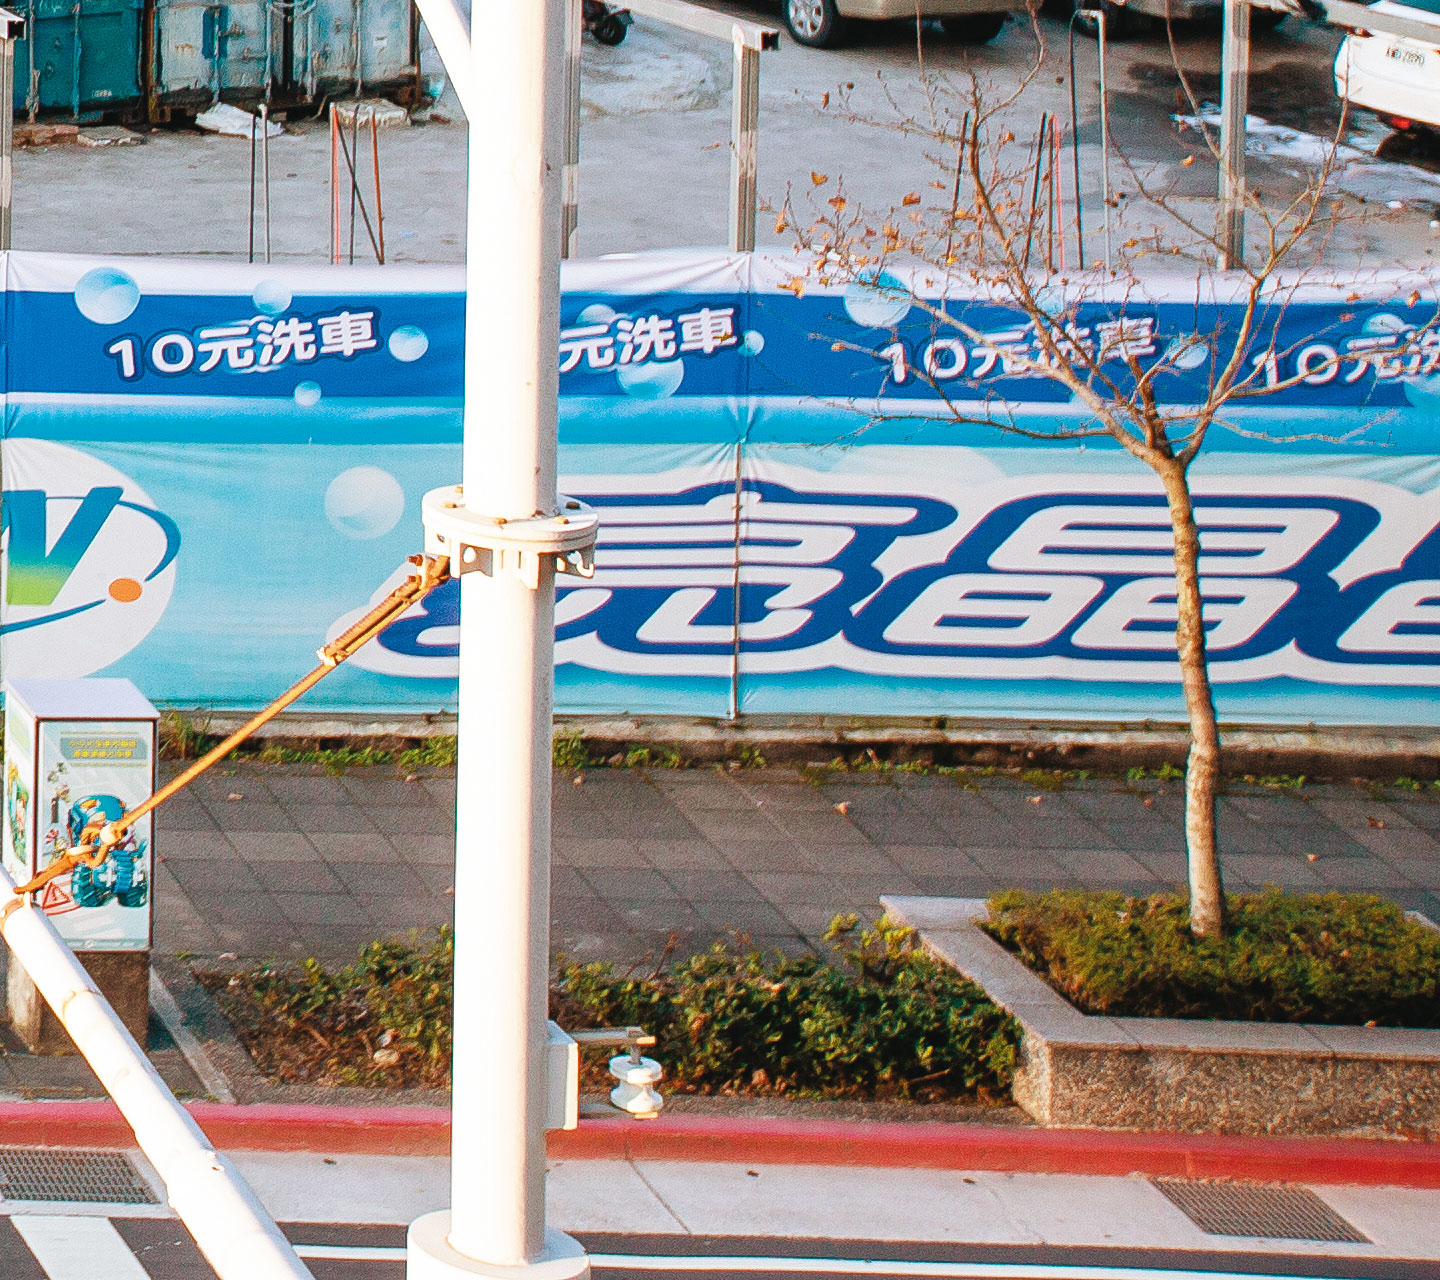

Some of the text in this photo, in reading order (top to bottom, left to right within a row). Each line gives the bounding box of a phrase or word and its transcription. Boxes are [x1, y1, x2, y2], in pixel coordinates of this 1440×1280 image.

[105, 308, 378, 382] 10元洗車
[878, 315, 1158, 386] 10元洗車
[380, 480, 1440, 661] 亮晶
